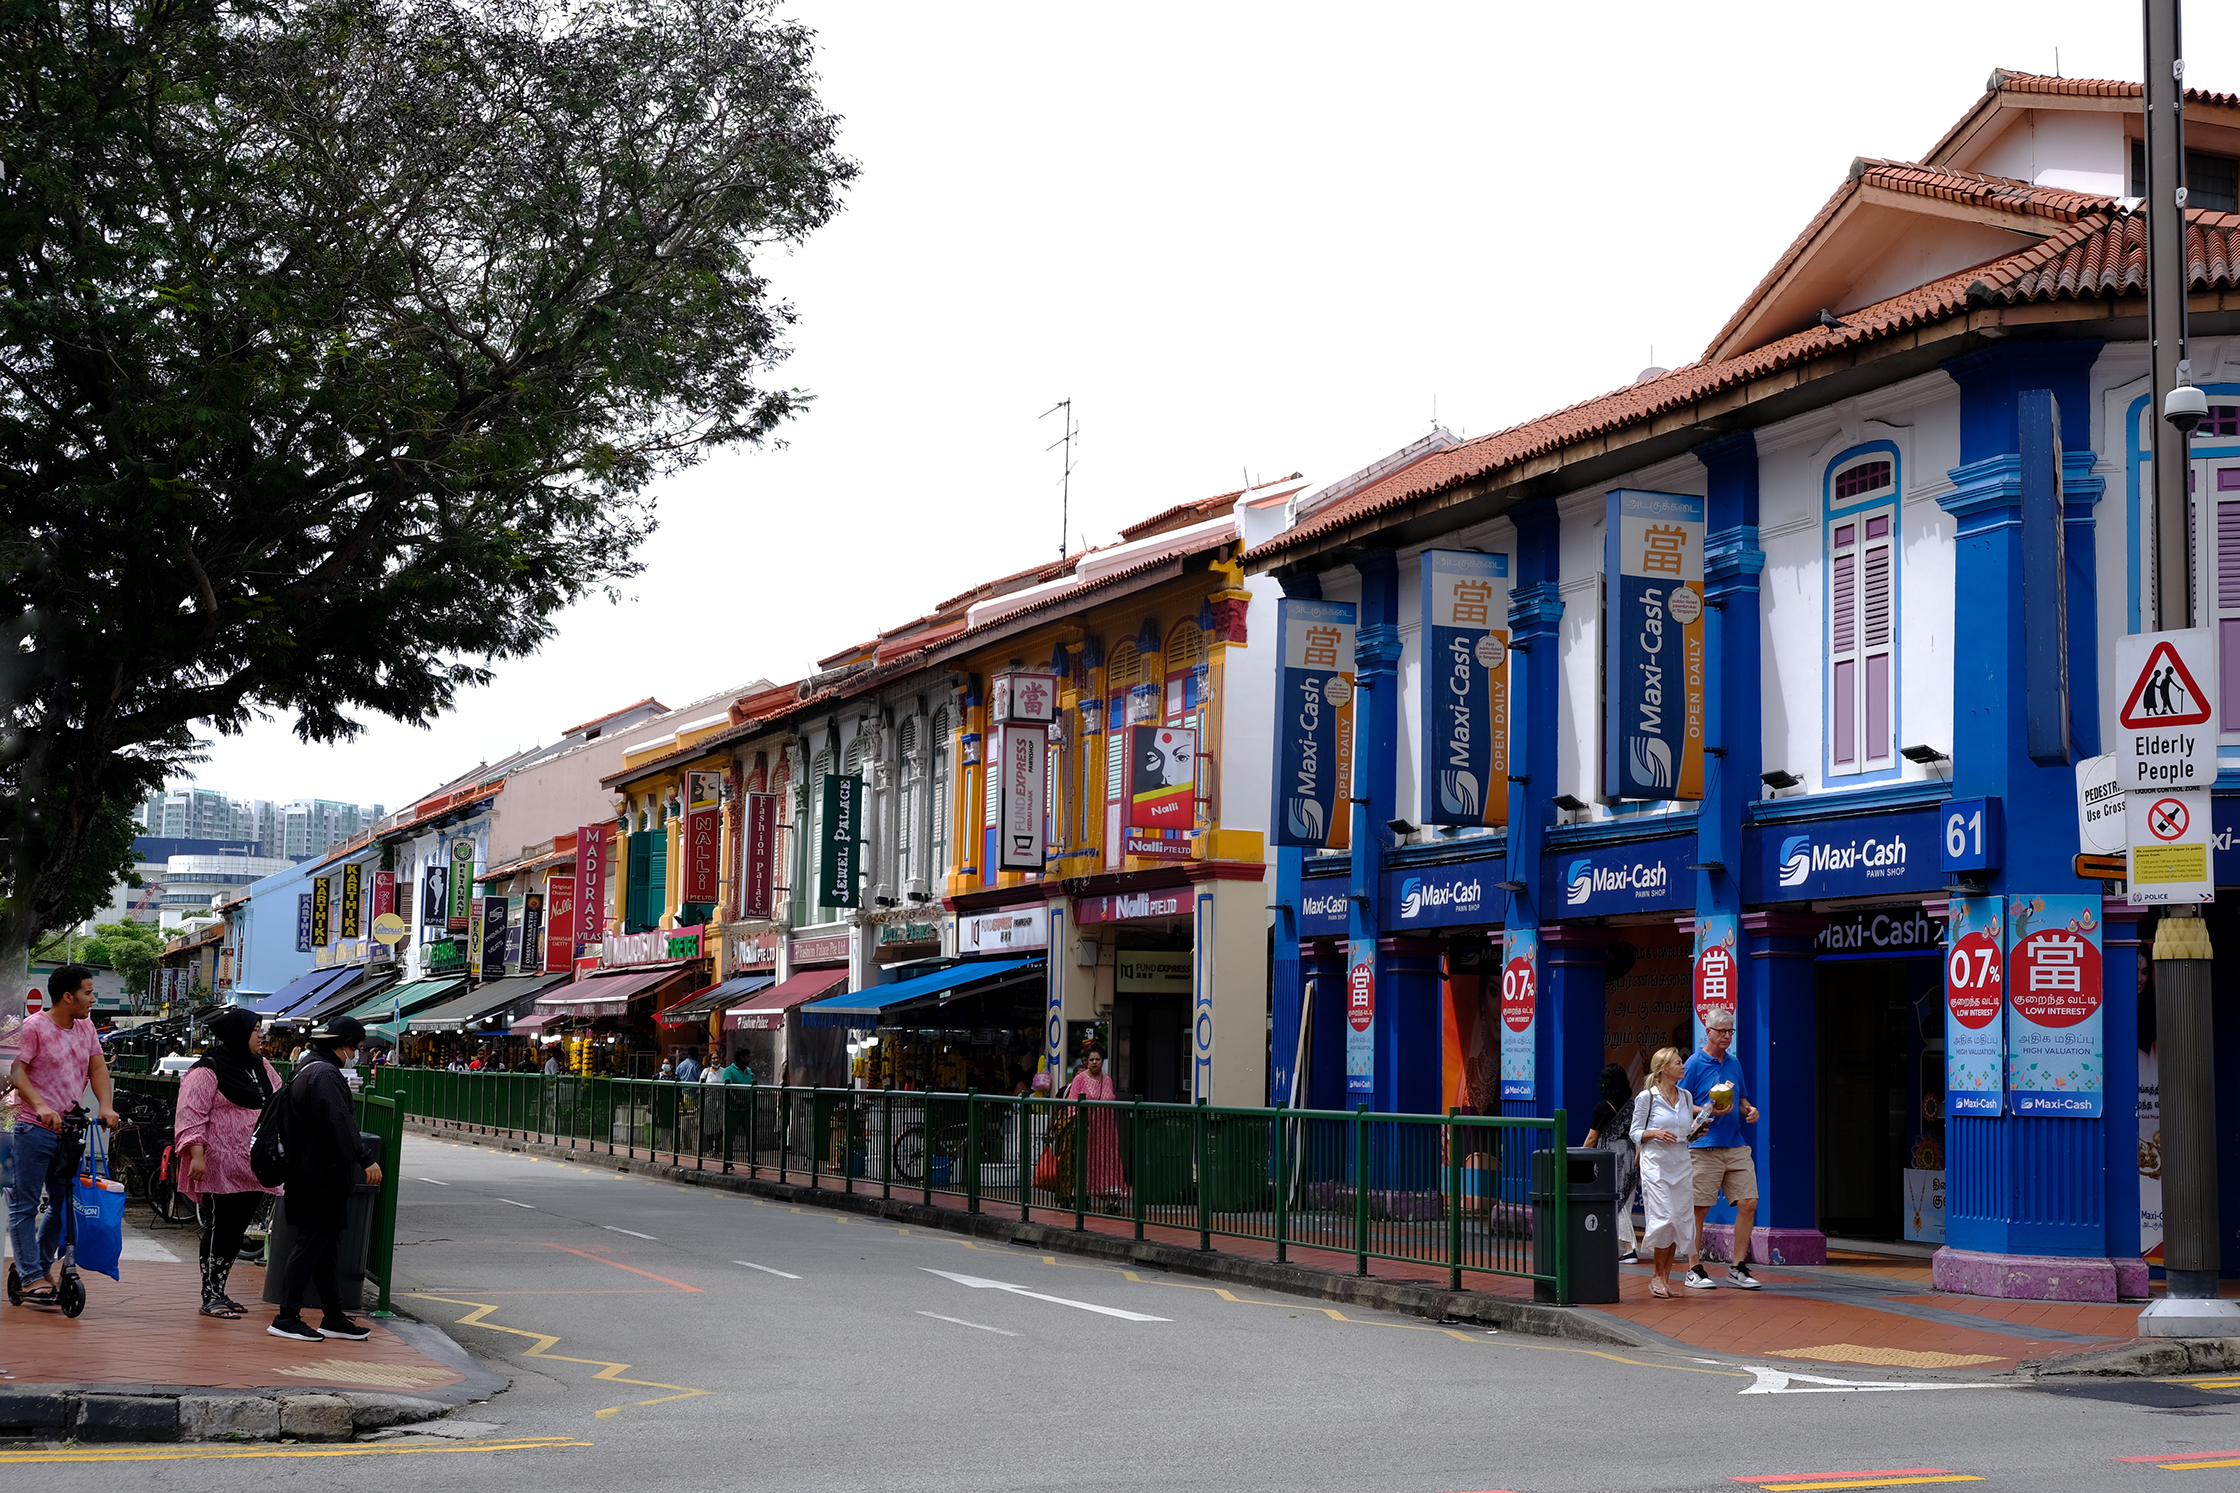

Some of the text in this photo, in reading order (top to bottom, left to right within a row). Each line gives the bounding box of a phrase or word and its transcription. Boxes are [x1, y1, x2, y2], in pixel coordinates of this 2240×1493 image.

[1638, 587, 1662, 734] Maxi-Cash
[1019, 681, 1049, 716] 當
[1689, 637, 1702, 738] OPEN DAILY
[1448, 636, 1470, 768] Maxi-Cash
[1297, 676, 1321, 796] Maxi-Cash
[1494, 680, 1506, 771] OPEN DAILY
[1338, 718, 1351, 800] OPEN DAILY
[2136, 733, 2195, 758] Elderly
[2138, 759, 2194, 784] People
[1150, 802, 1179, 816] Nalli
[2086, 809, 2101, 823] Use
[831, 779, 851, 903] JEWEL PALACE
[1128, 840, 1191, 854] Nalli PTE LTD
[1946, 810, 1982, 858] 61
[755, 797, 765, 909] Fashion Palace
[1811, 834, 1906, 872] Maxi-Cash
[585, 829, 600, 930] MADURAS
[1592, 860, 1667, 893] Maxi-Cash
[1866, 867, 1906, 878] PAWN SHOP
[344, 865, 358, 936] KARTHIKA
[457, 863, 466, 917] RESTAURANT
[1421, 878, 1481, 906] Maxi-Cash
[1635, 888, 1666, 898] PAWN SHOP
[314, 879, 327, 945] KARTHIKA
[1115, 893, 1177, 919] Nalli PTE LTD
[1302, 894, 1348, 916] Maxi-Cash
[299, 895, 311, 950] KARTHIKA
[485, 924, 506, 943] PREMIUM
[487, 940, 504, 955] MEATS
[576, 932, 602, 941] VILAS
[1950, 948, 2001, 989] 0.7%
[1503, 969, 1535, 1001] 0.7%
[1956, 1009, 1969, 1017] LOW
[2025, 1007, 2087, 1016] LOW INTEREST
[1956, 1048, 1996, 1056] HIGH VALUATION
[2023, 1047, 2091, 1055] HIGH VALUATION
[1352, 1080, 1371, 1088] Maxi-Cash
[1509, 1085, 1531, 1094] Maxi-Cash
[1963, 1097, 1997, 1109] Maxi-Cash
[2034, 1098, 2093, 1110] Maxi-Cash
